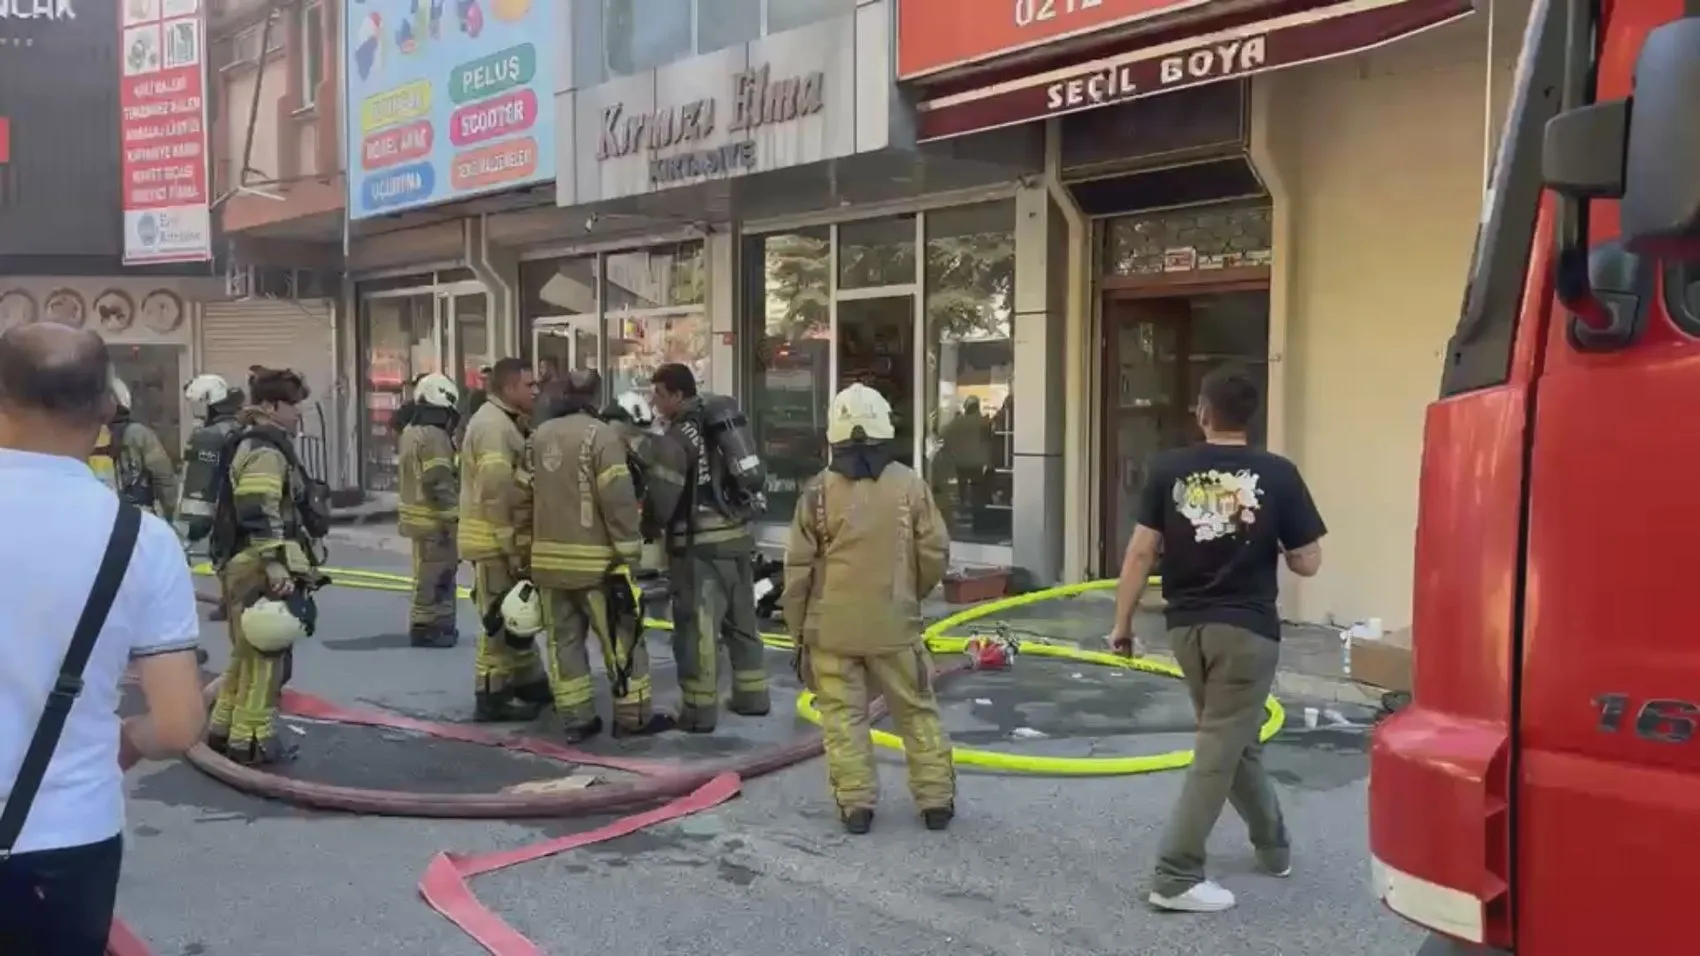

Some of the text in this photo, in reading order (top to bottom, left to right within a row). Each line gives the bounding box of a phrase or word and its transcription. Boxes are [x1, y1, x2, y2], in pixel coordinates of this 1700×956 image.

[462, 56, 521, 94] PELUŞ
[1160, 35, 1266, 84] BOYA
[461, 98, 525, 137] SCOOTER
[596, 61, 825, 162] Kırmızı Elma
[1589, 692, 1698, 744] 16
